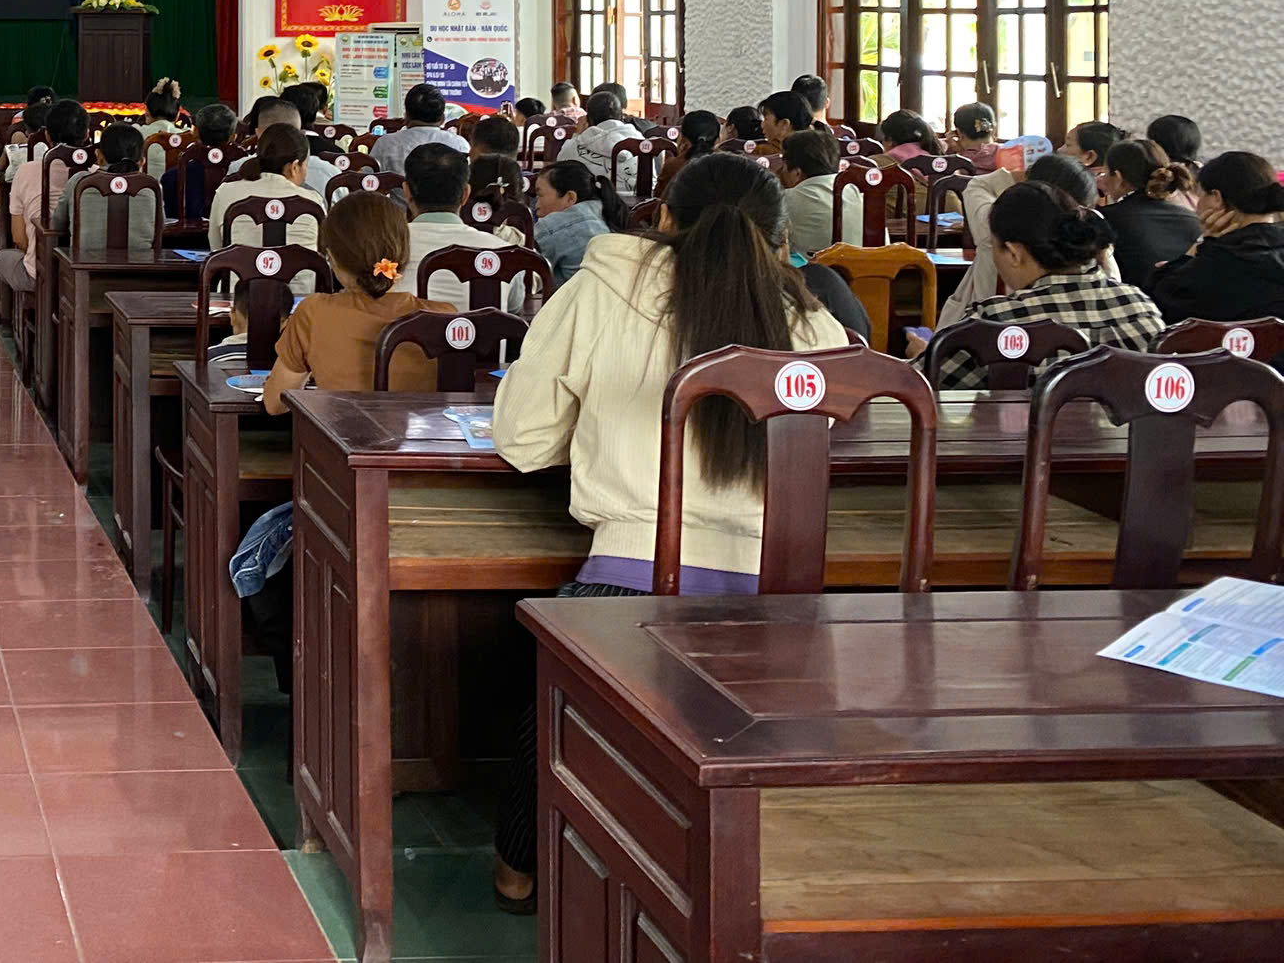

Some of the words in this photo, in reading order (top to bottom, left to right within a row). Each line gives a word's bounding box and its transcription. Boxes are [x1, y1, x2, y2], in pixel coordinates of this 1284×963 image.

[270, 204, 280, 215] 94
[477, 207, 486, 216] 95
[263, 257, 274, 269] 97
[481, 257, 493, 269] 98
[452, 326, 470, 341] 101
[1003, 334, 1025, 351] 103
[1229, 336, 1249, 352] 147
[784, 373, 816, 400] 105
[1154, 376, 1186, 400] 106
